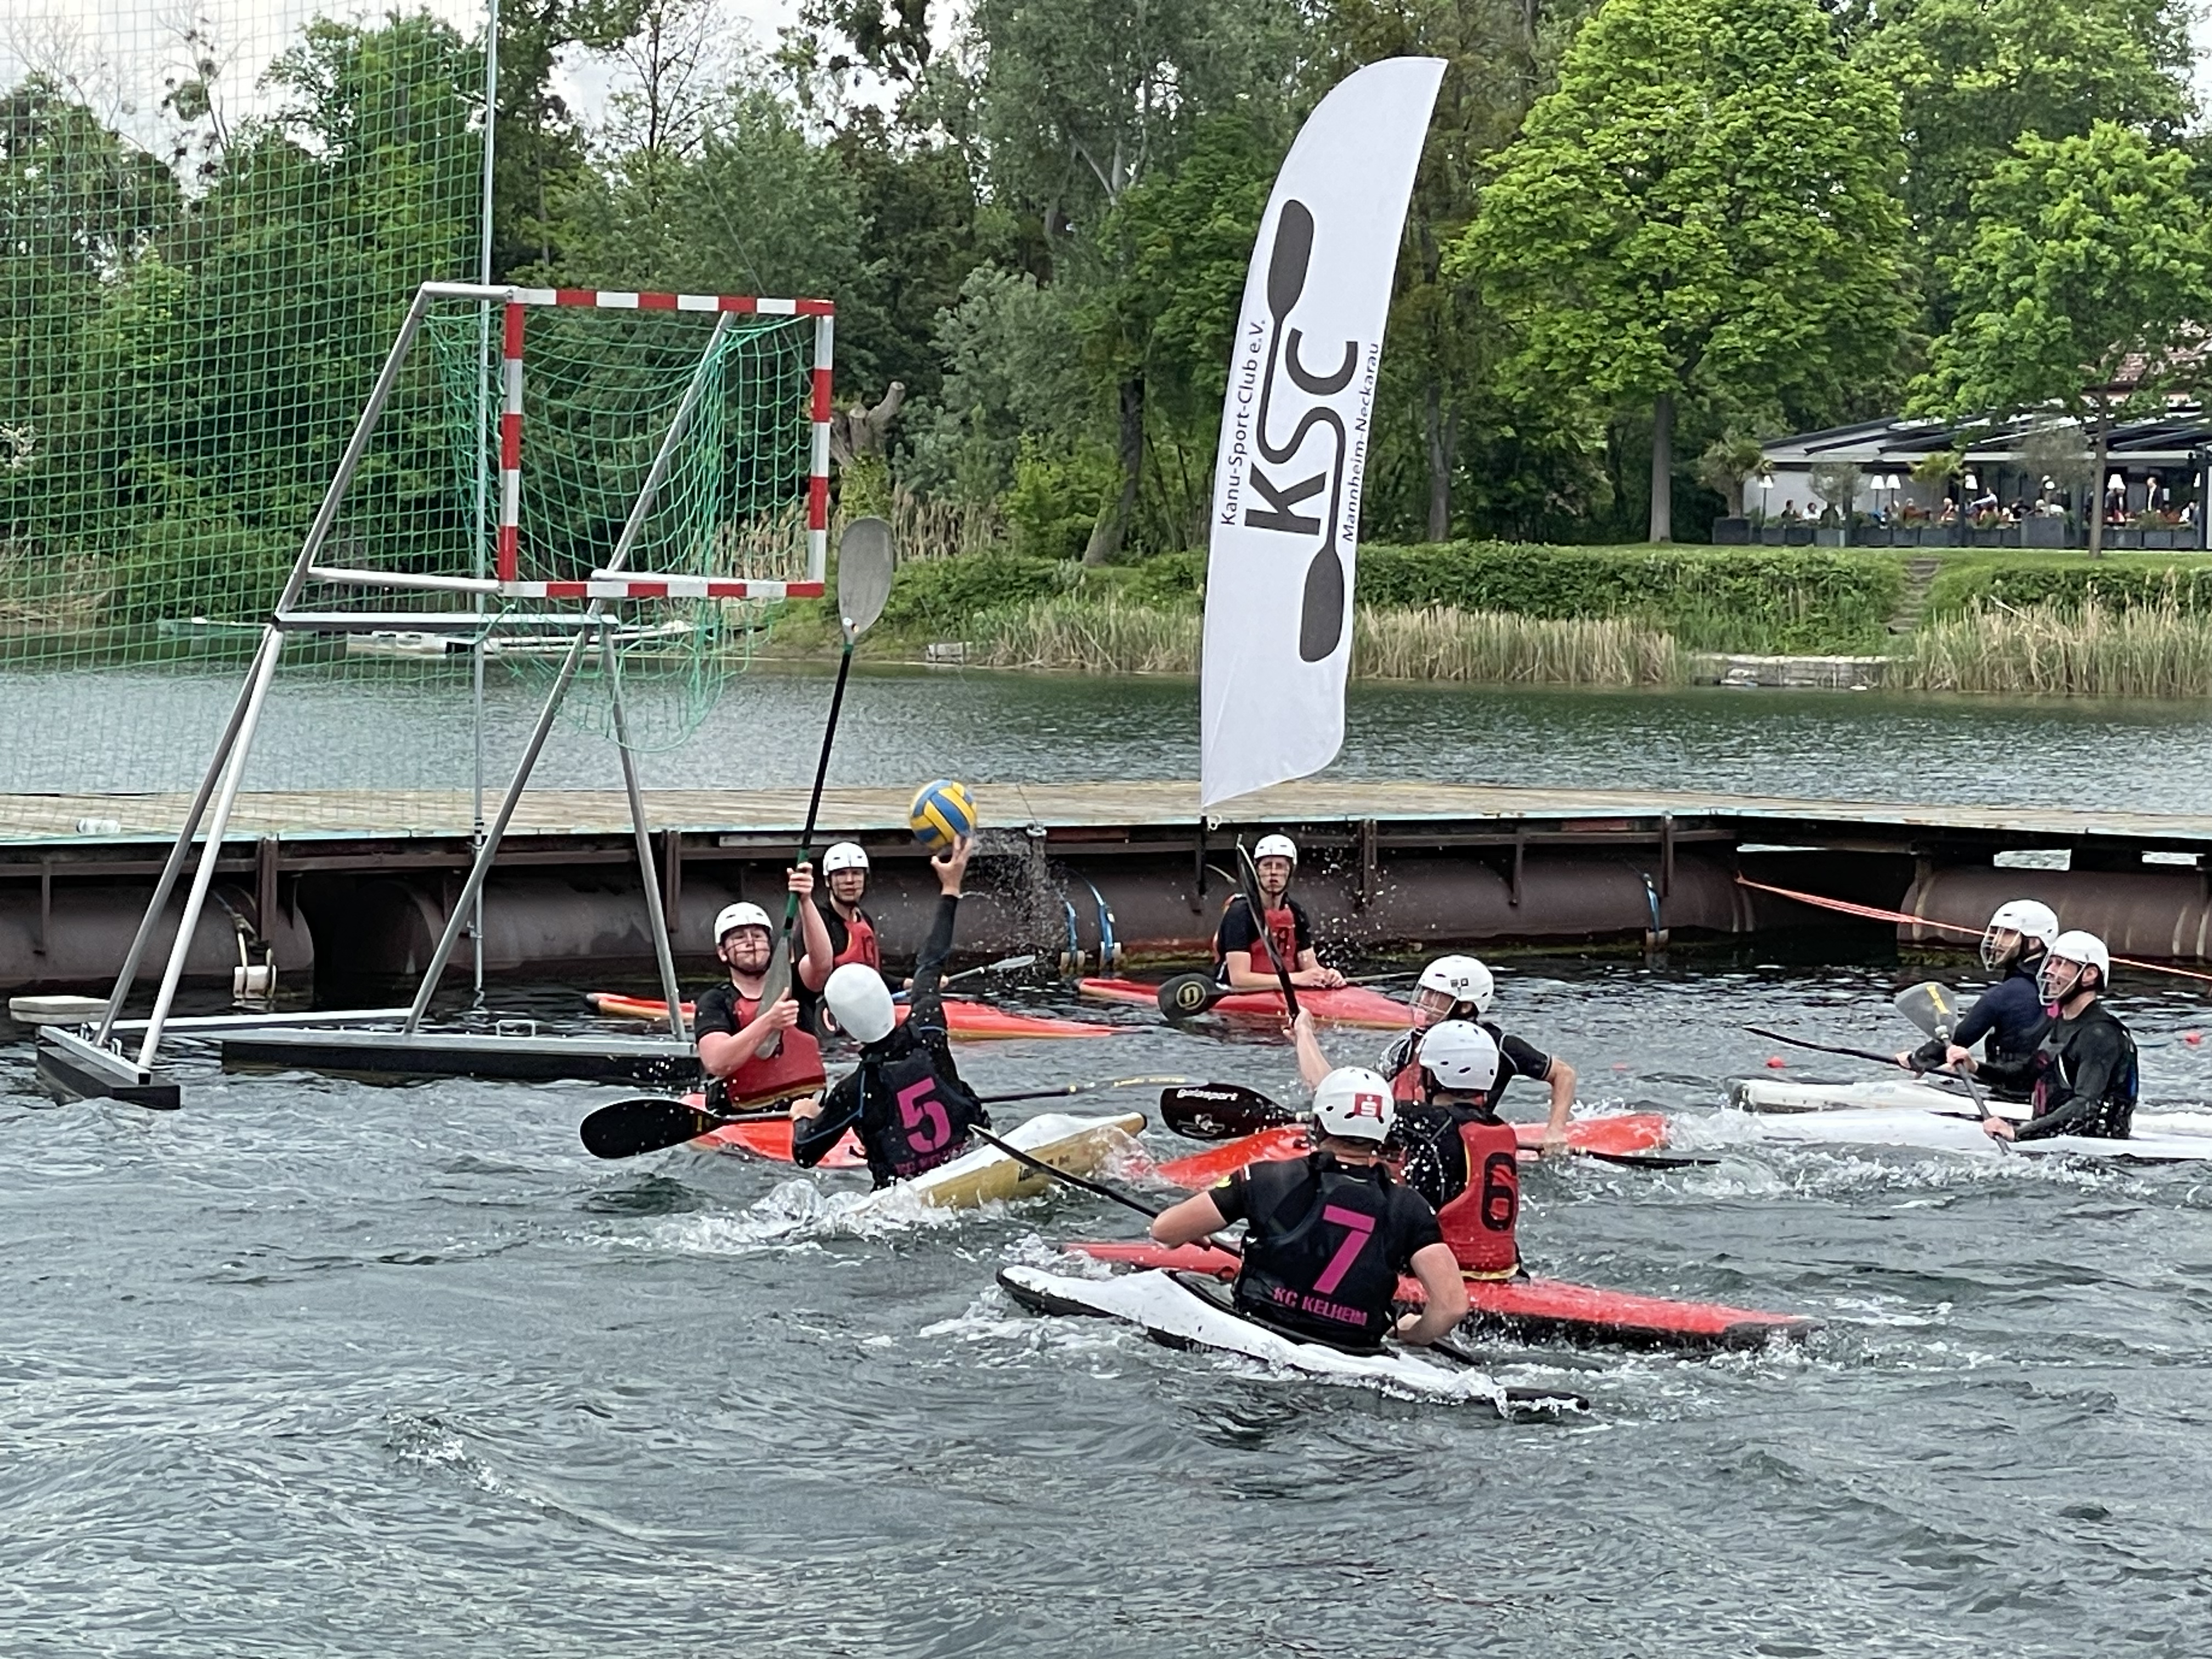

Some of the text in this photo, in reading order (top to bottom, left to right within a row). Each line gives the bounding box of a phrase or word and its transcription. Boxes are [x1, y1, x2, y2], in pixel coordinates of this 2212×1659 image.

[1221, 320, 1266, 525] Kanu-Sport-Club e.V.
[1244, 328, 1358, 535] KSC
[1342, 343, 1379, 541] Mannheim-Neckarau
[897, 1077, 951, 1153] 5
[1482, 1152, 1517, 1231] 6
[1313, 1204, 1376, 1295] 7
[1273, 1287, 1298, 1308] KC
[1302, 1296, 1368, 1326] KELHEIM
